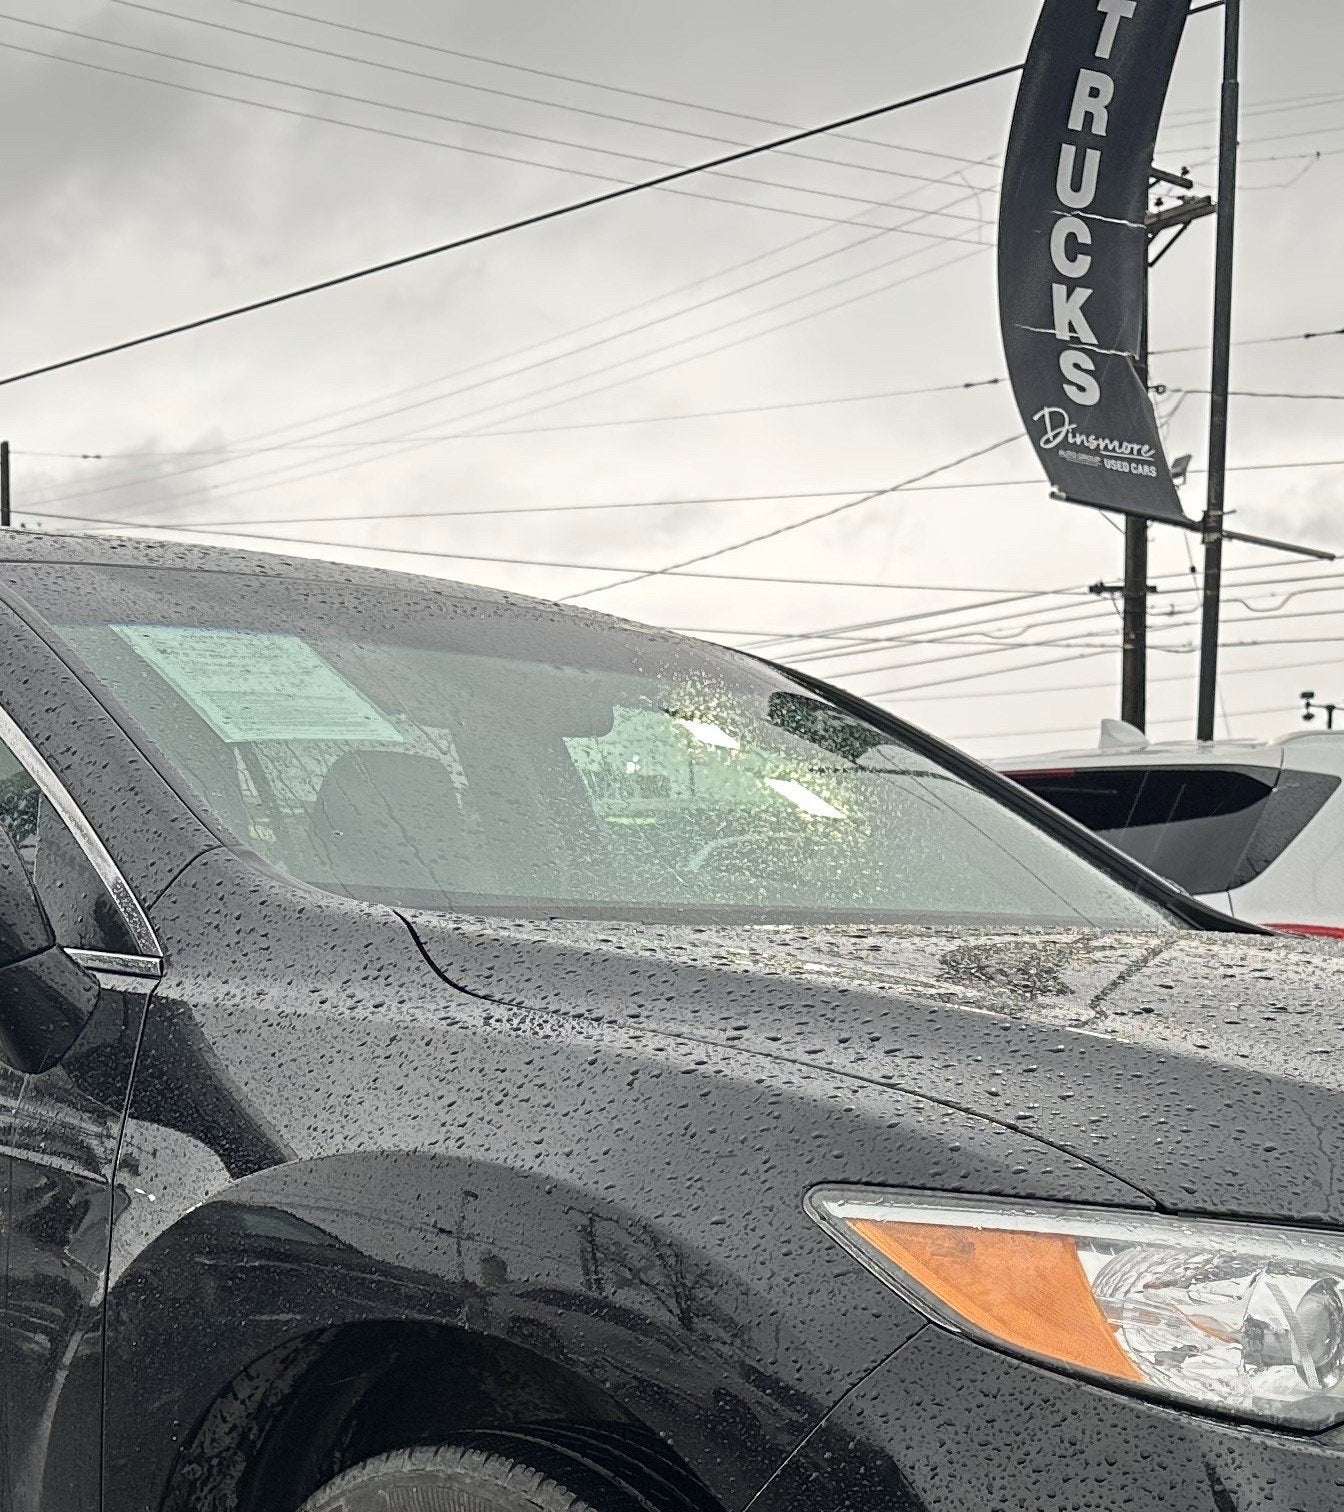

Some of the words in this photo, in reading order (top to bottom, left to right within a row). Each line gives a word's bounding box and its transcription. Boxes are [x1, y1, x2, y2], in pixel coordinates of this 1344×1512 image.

[1049, 0, 1137, 407] TRUCKS
[1032, 406, 1155, 457] Dinsmore
[1103, 458, 1130, 472] USED
[1130, 464, 1157, 478] CARS
